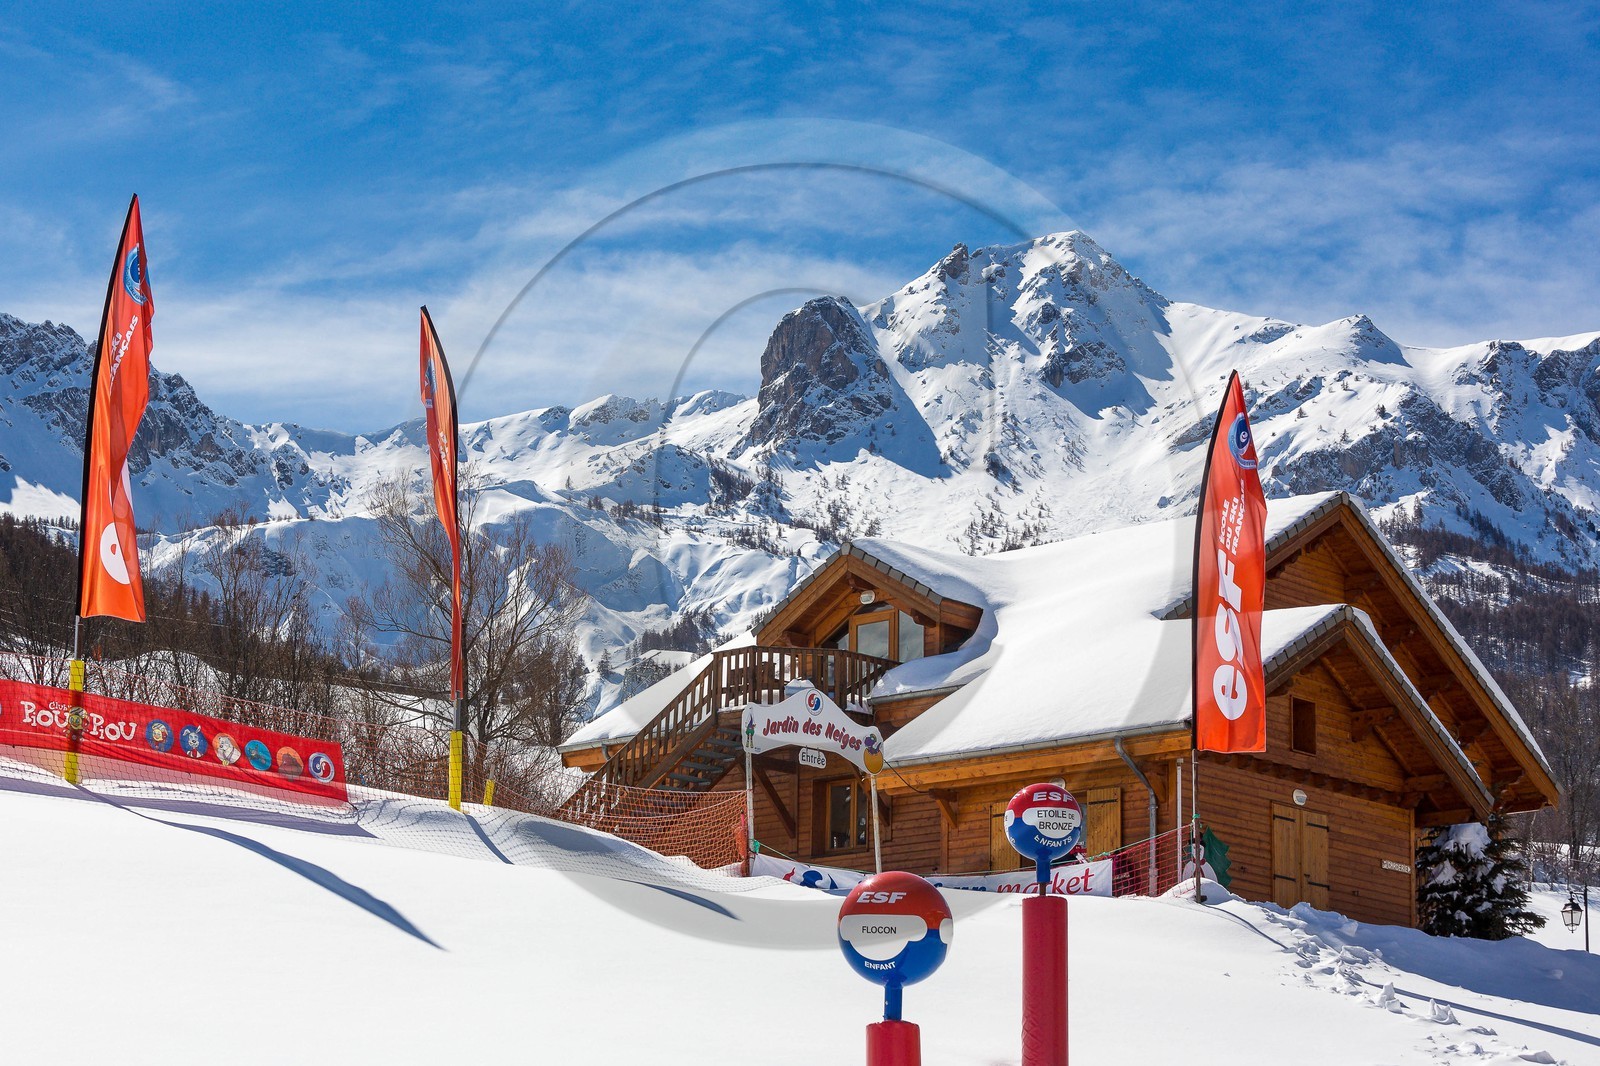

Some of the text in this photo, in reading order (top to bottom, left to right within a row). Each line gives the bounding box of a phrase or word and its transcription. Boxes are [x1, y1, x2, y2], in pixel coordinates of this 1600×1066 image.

[1225, 496, 1239, 550] DU SKI
[763, 715, 863, 751] Jardin des Neiges
[1032, 791, 1073, 802] ESF
[1037, 809, 1067, 819] ETOILE
[1038, 821, 1073, 831] BRONZE
[1034, 834, 1073, 848] ENFANTS
[857, 891, 907, 904] ESF
[861, 925, 897, 935] FLOCON
[864, 960, 896, 971] ENFANT
